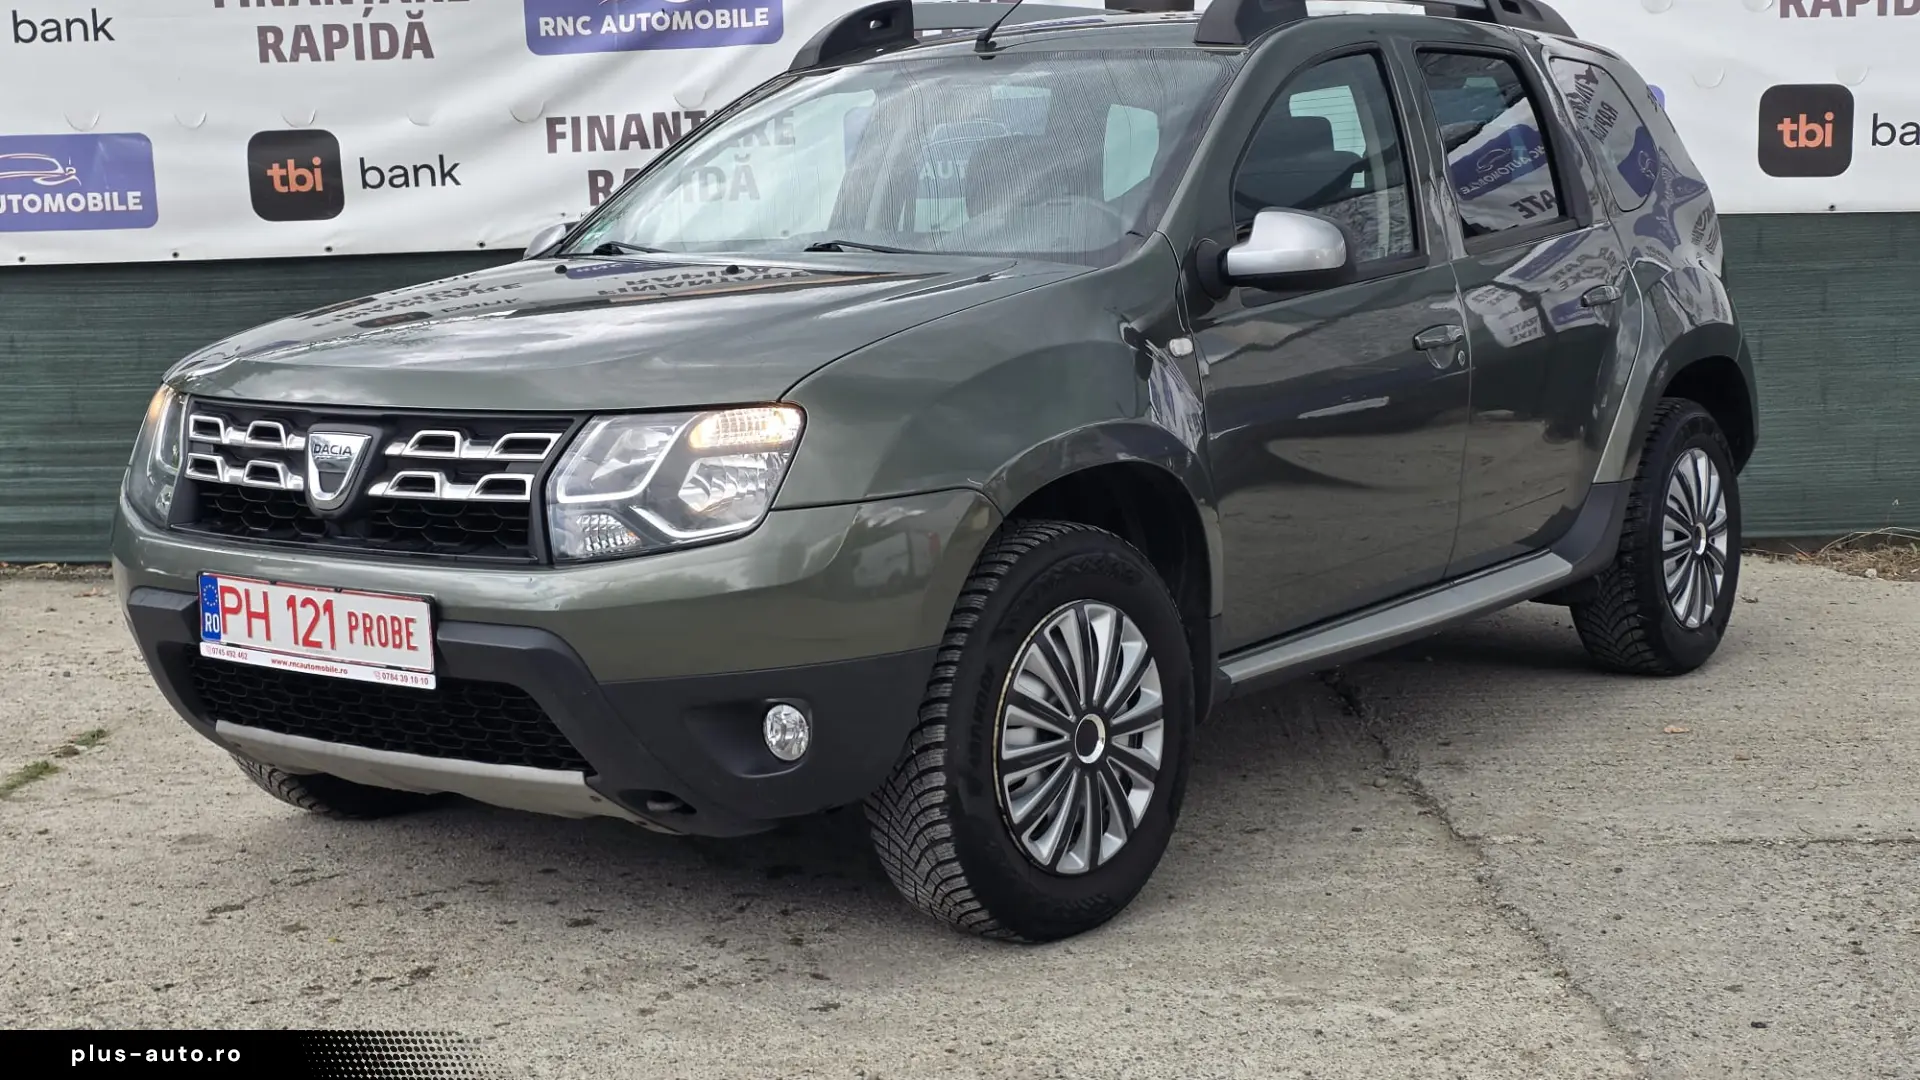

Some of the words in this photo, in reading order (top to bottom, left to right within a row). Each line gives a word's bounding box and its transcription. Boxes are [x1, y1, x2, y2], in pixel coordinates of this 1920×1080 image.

[11, 9, 115, 43] bank
[539, 16, 592, 37] RNC
[600, 7, 769, 34] AUTOMOBILE
[1777, 112, 1833, 148] tbi
[266, 156, 324, 194] tbi
[359, 154, 462, 190] bank
[313, 444, 352, 455] DACIA
[205, 612, 220, 634] RO
[219, 585, 272, 641] PH
[286, 594, 336, 650] 121
[347, 611, 419, 651] PROBE
[270, 657, 348, 675] www.rncautomobile.ro
